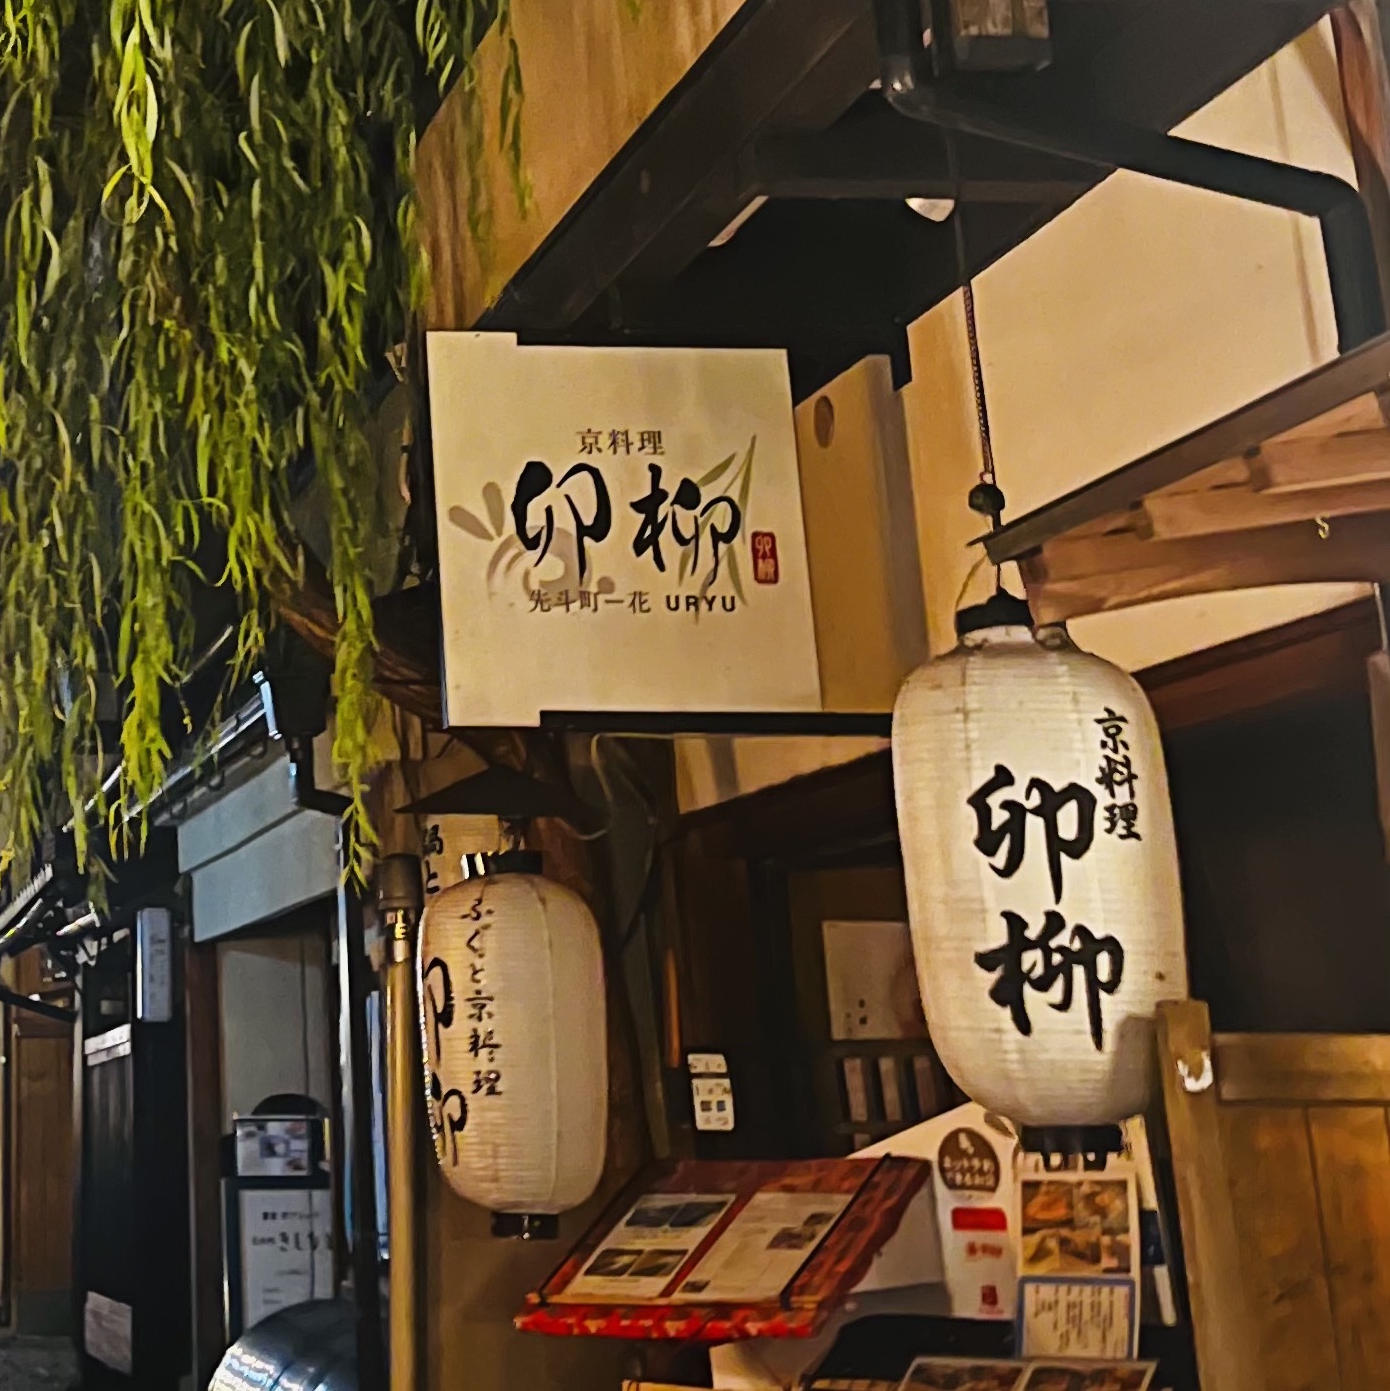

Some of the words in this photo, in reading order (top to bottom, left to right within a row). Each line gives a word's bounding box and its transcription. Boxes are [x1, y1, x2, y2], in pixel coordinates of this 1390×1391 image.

[576, 428, 666, 455] 京料理
[511, 461, 741, 587] 卯柳
[529, 589, 652, 614] 先斗町一花
[665, 594, 736, 613] URYU
[1094, 707, 1143, 842] 京料理
[966, 764, 1125, 1052] 卯柳
